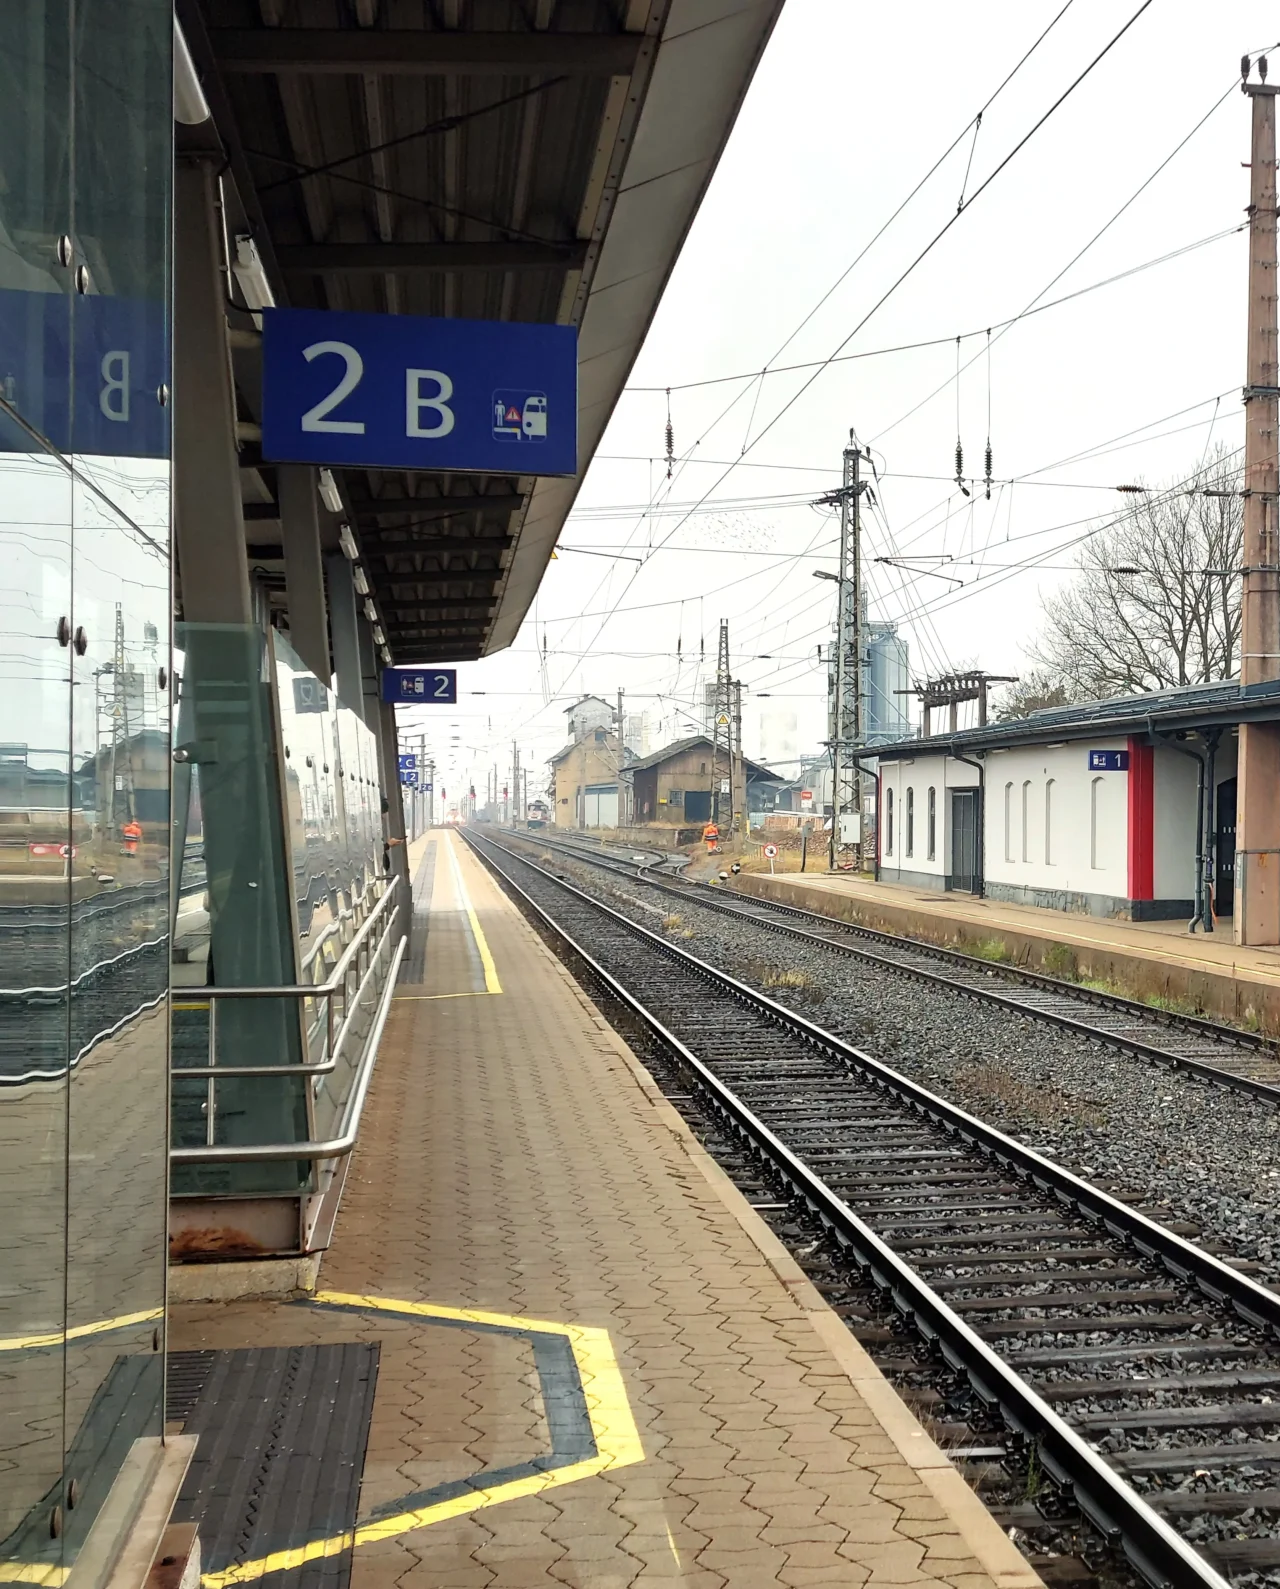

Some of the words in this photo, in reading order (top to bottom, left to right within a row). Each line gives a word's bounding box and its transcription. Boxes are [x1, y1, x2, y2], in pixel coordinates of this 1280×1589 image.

[301, 340, 365, 435] 2
[405, 368, 455, 438] B
[434, 675, 450, 697] 2
[405, 759, 413, 768] C
[1115, 754, 1121, 768] 1
[409, 773, 416, 781] 2
